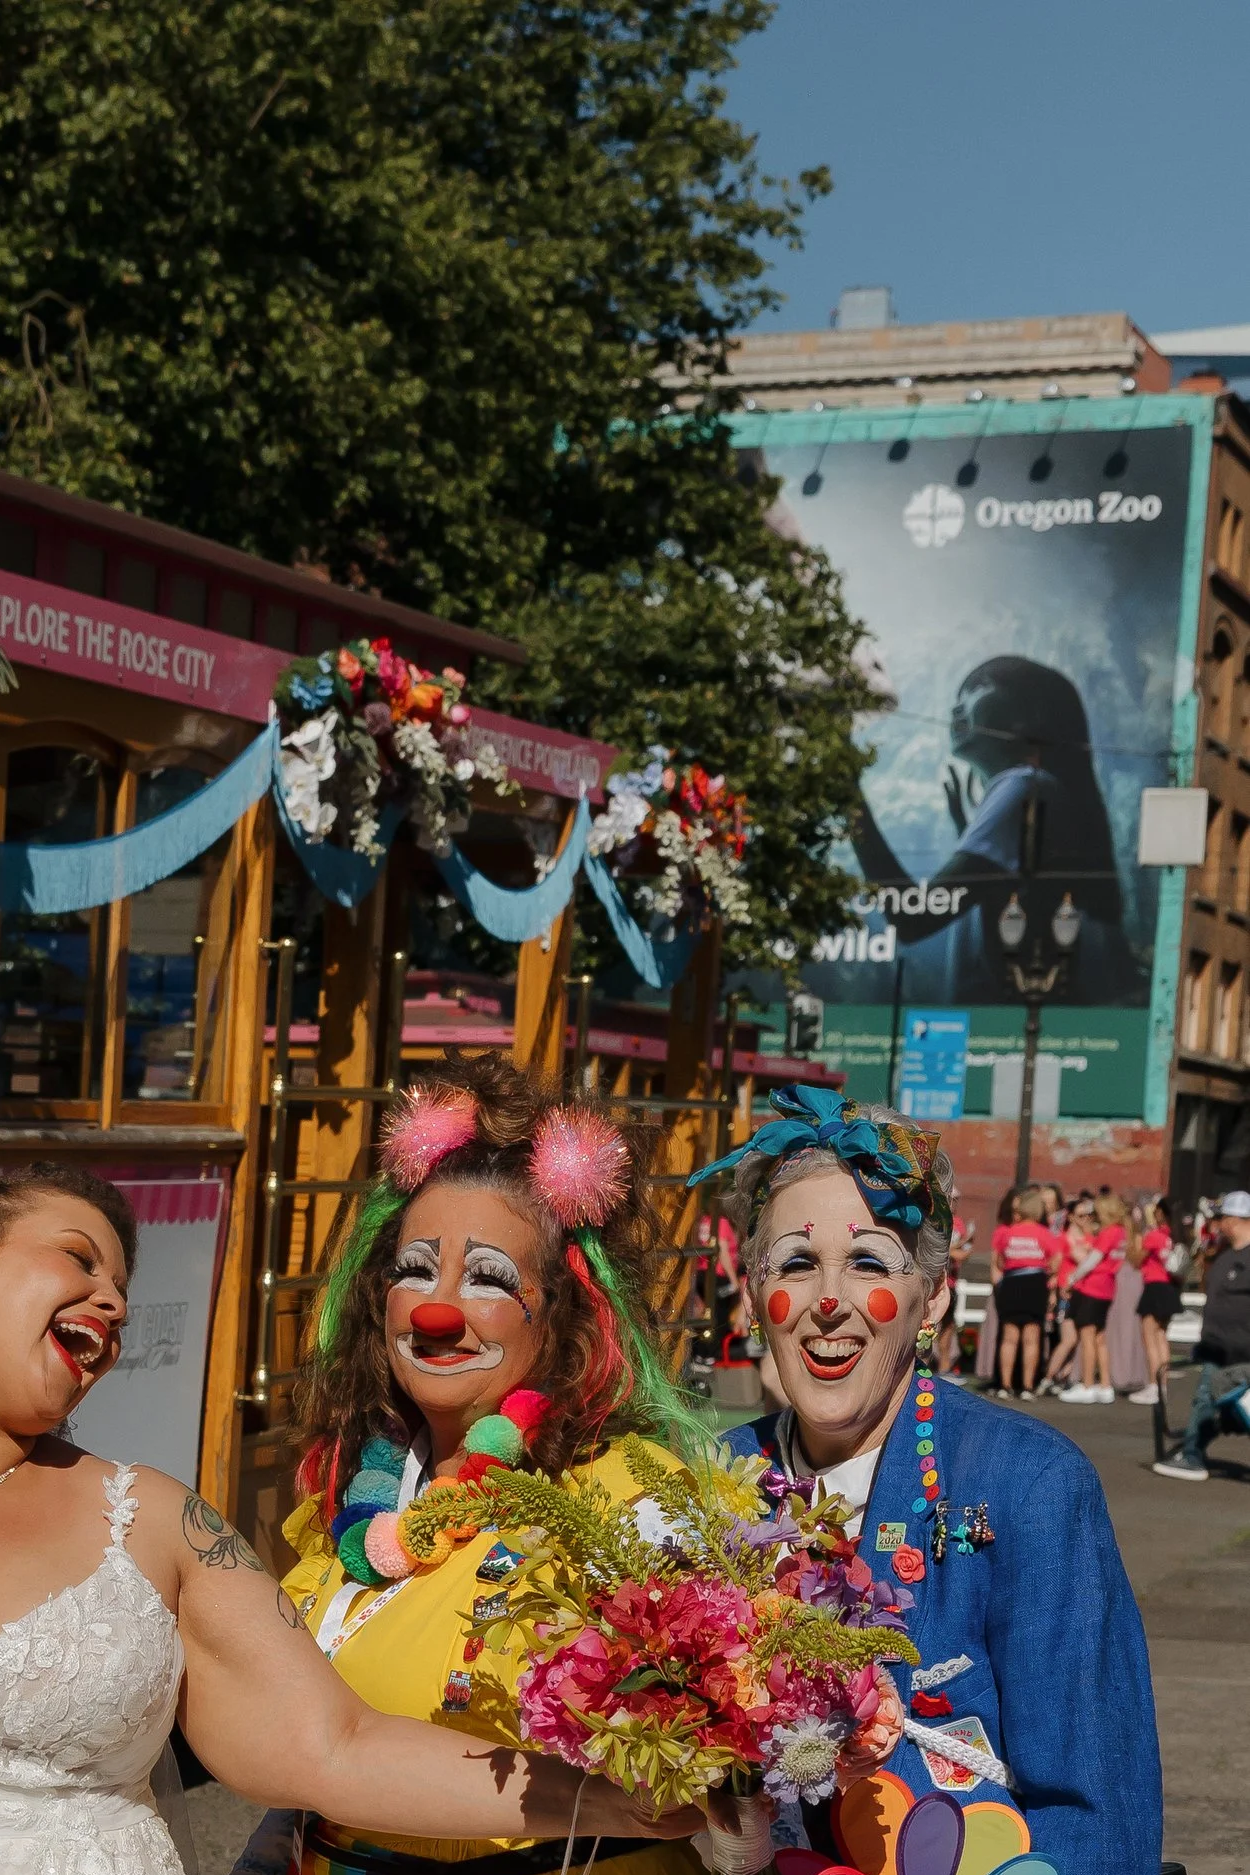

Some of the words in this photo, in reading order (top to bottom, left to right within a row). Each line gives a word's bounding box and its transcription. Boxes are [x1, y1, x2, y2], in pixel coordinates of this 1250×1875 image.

[975, 497, 1094, 532] Oregon
[1096, 490, 1162, 523] Zoo
[74, 615, 115, 665] THE
[118, 627, 171, 679] ROSE
[172, 644, 216, 691] CITY
[837, 877, 969, 915] onder
[811, 924, 897, 963] wild
